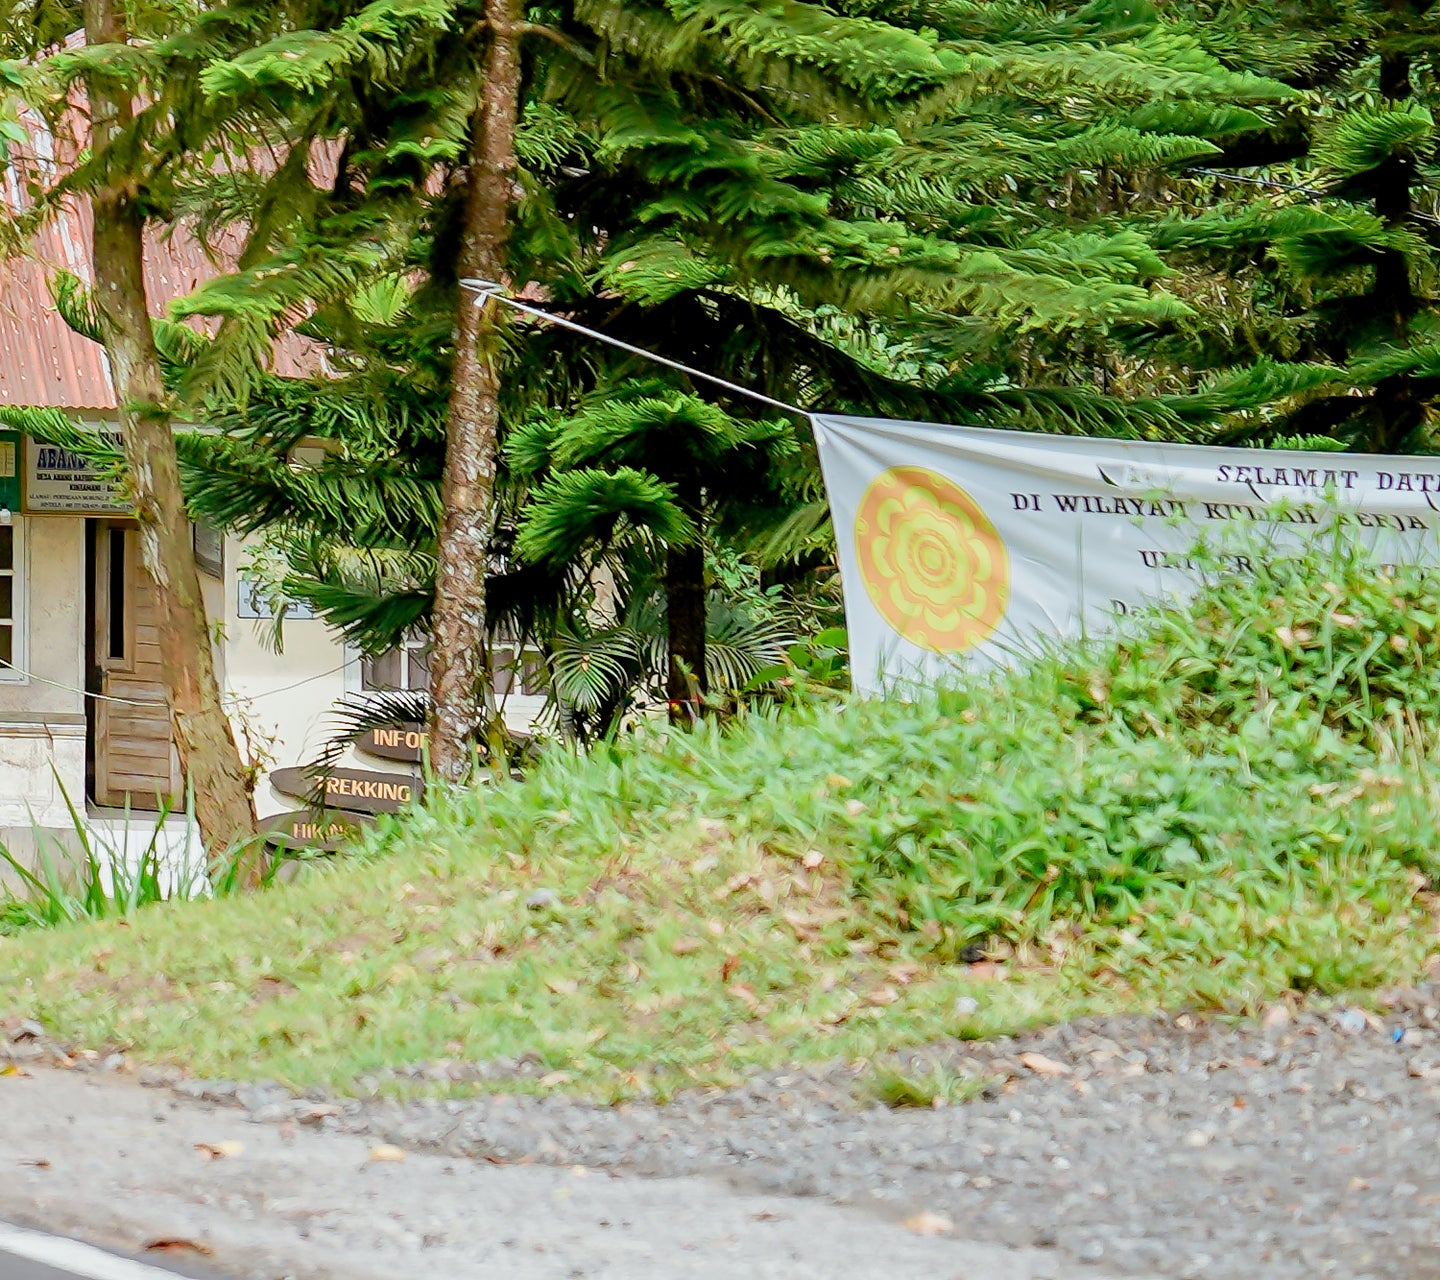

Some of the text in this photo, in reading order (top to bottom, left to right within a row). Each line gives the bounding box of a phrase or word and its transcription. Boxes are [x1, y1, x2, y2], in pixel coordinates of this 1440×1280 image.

[1216, 463, 1440, 493] SELAMAT DAT
[1009, 493, 1043, 512] DI
